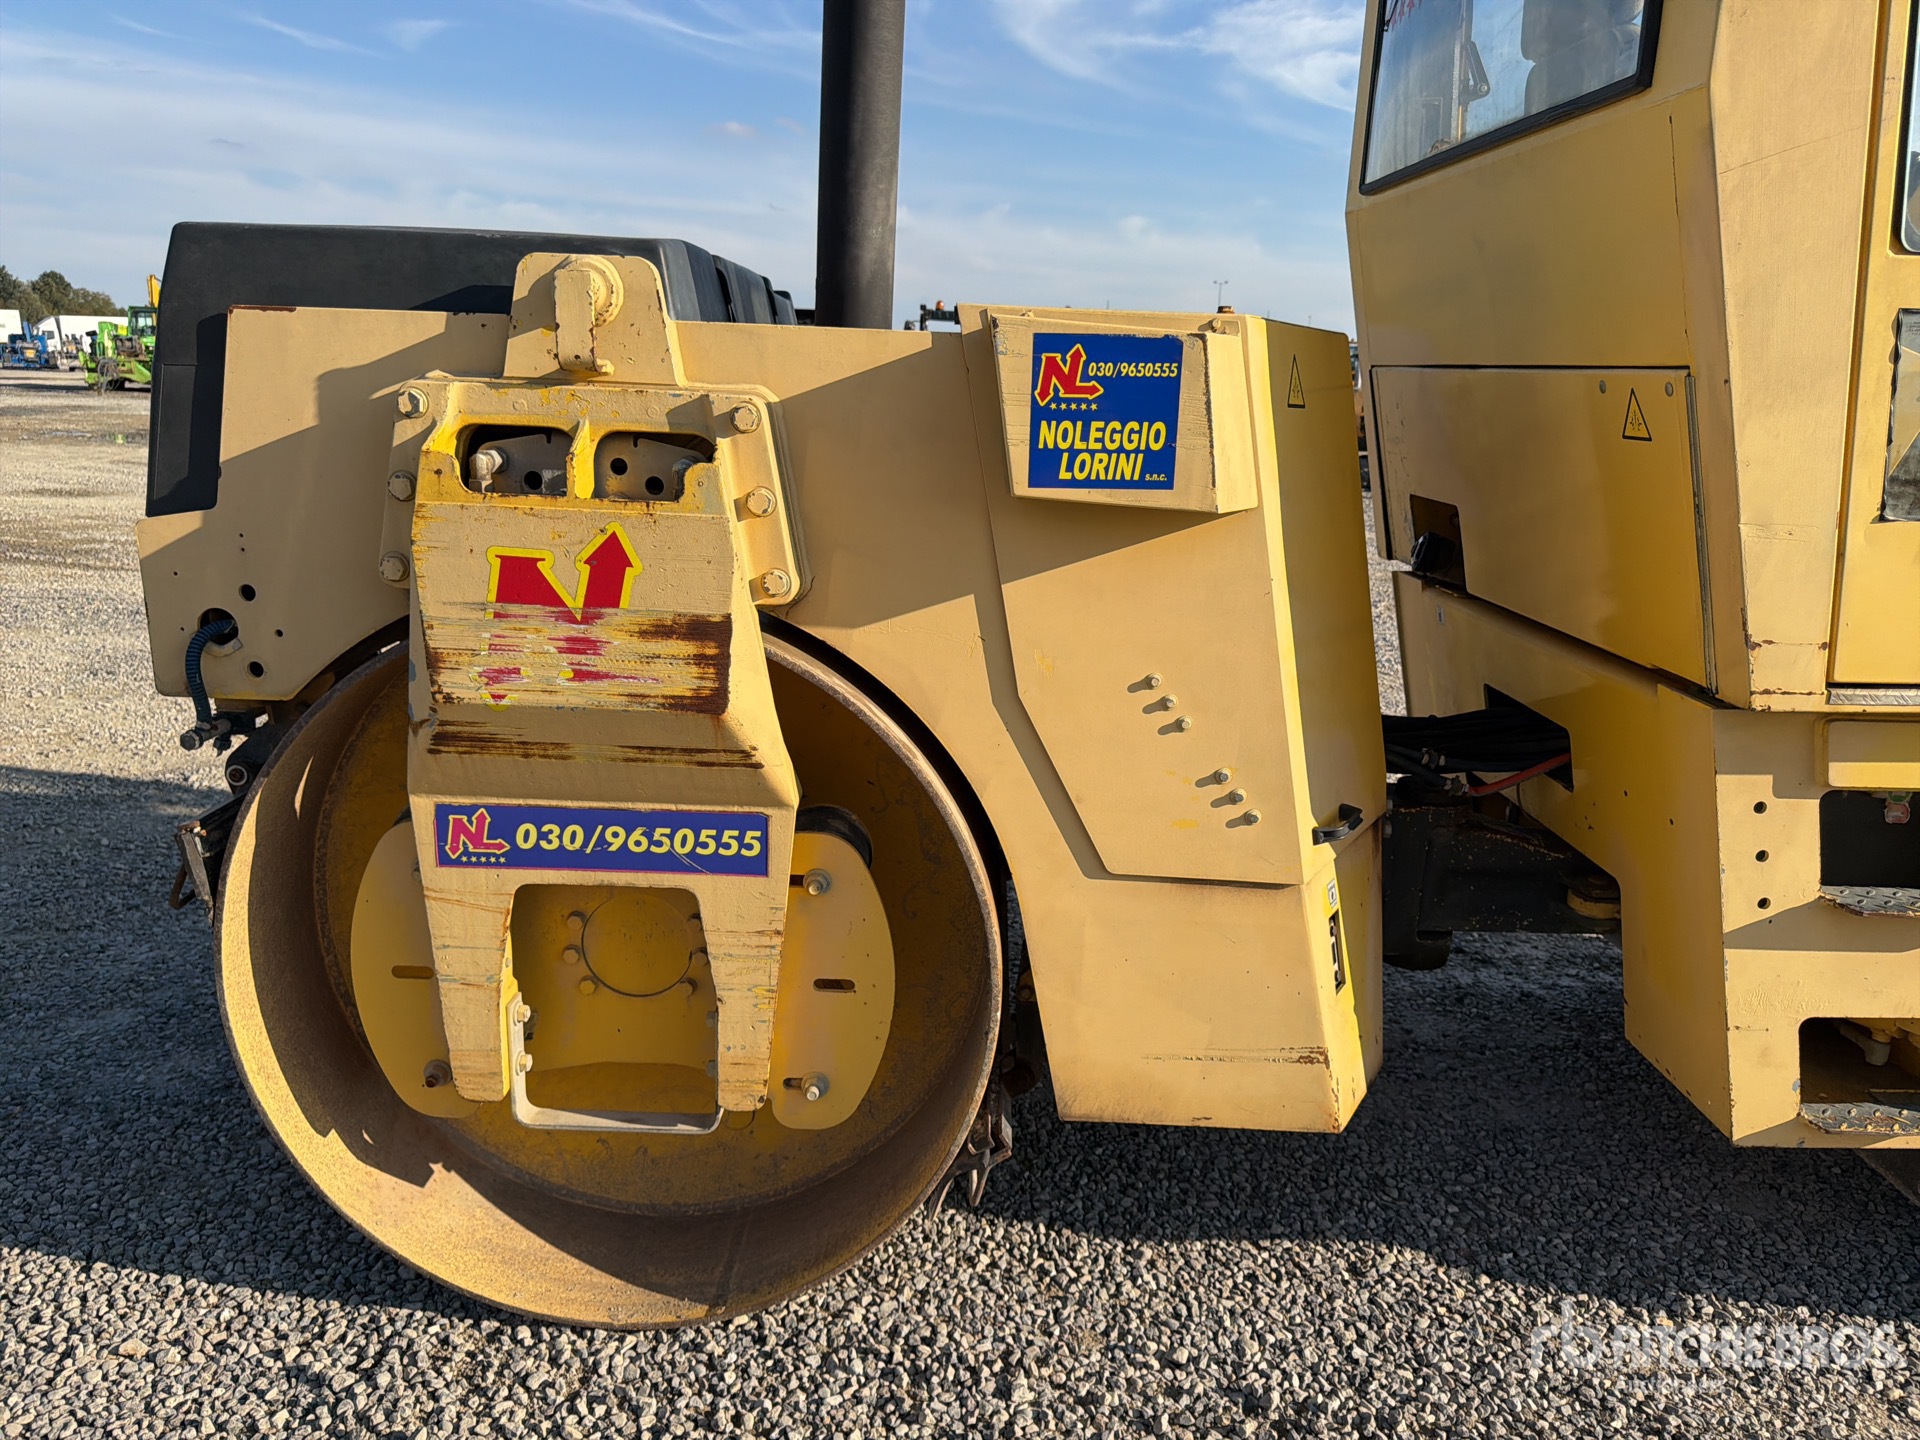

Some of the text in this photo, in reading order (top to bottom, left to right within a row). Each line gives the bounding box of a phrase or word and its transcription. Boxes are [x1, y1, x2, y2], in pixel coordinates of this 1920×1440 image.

[1088, 362, 1178, 378] 030/9650555
[1038, 420, 1166, 450] NOLEGGIO
[1058, 452, 1168, 481] LORINI s.n.c.
[515, 823, 762, 857] 030/9650555
